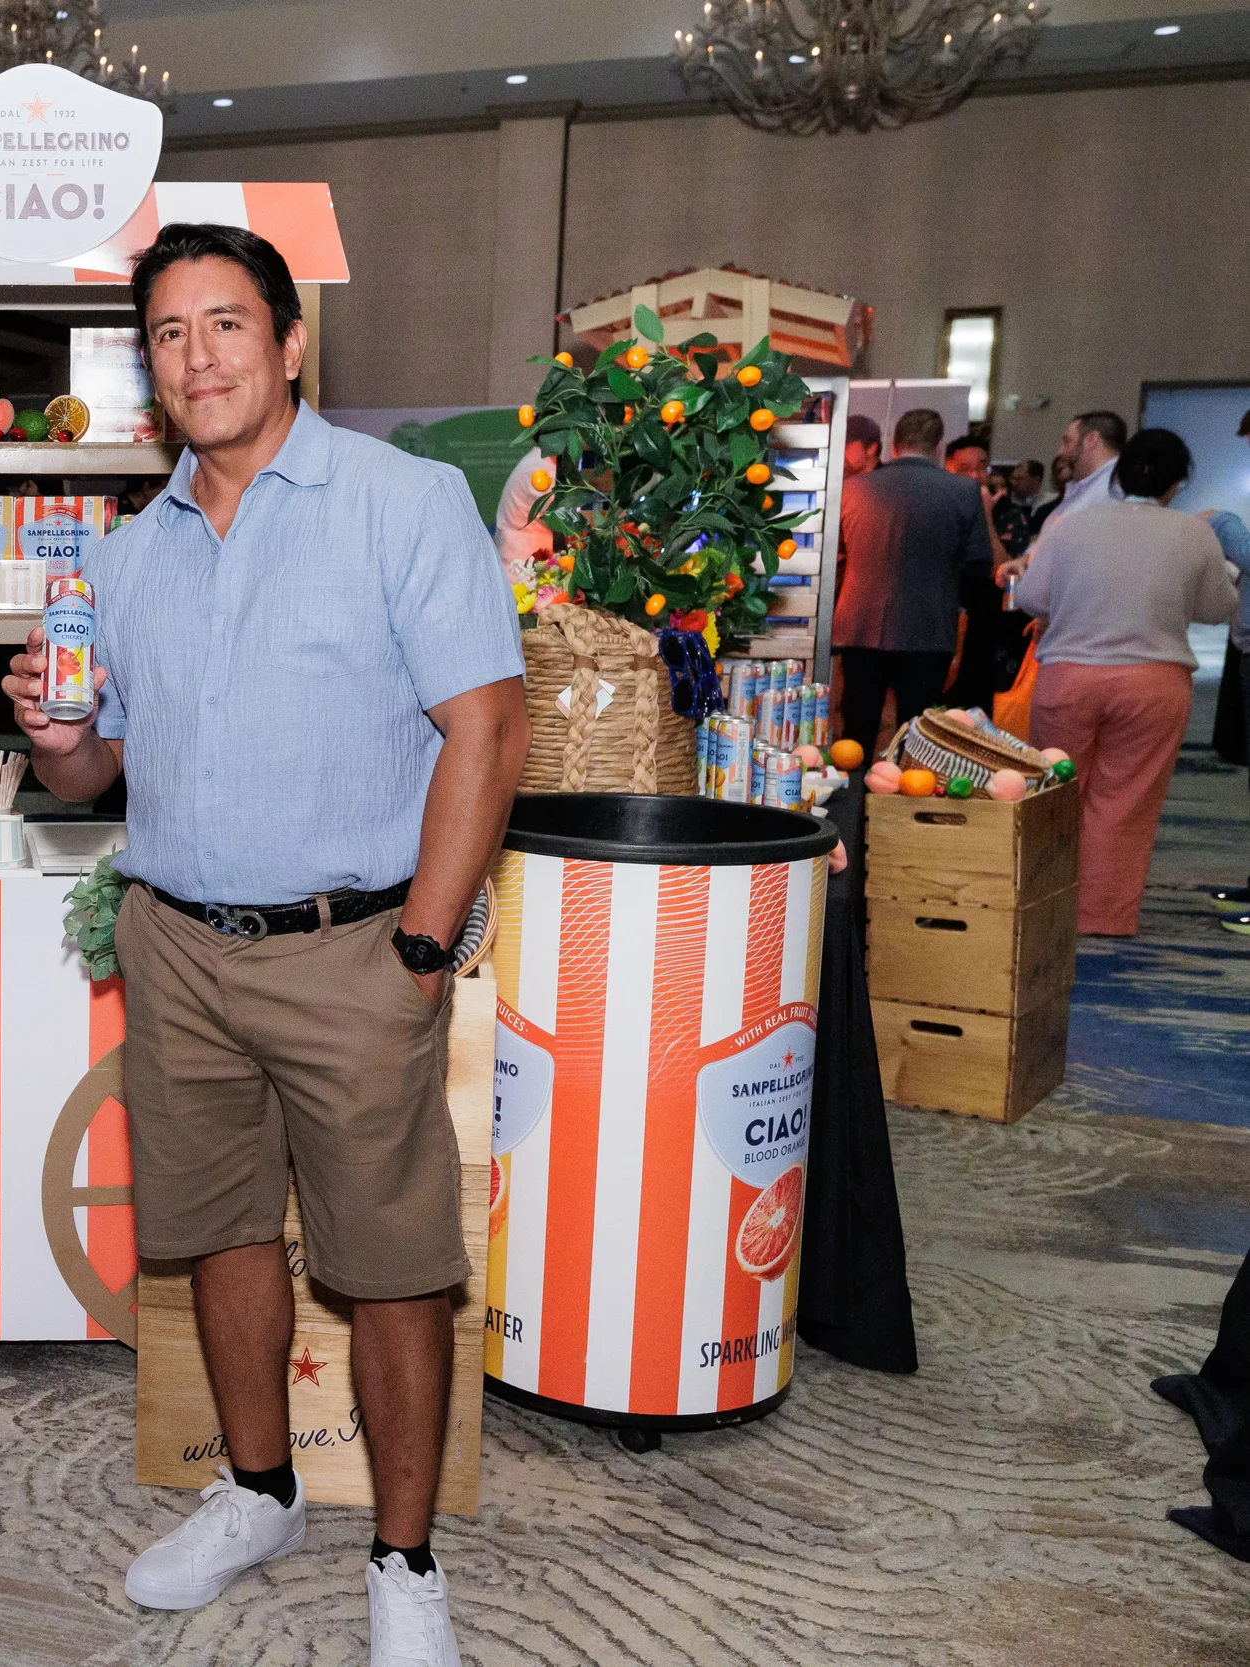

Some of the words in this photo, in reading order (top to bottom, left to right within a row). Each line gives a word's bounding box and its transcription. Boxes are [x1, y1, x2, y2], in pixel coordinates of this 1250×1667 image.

[0, 110, 21, 118] DAL
[54, 110, 76, 118] 1932
[22, 159, 48, 167] ZEST
[54, 159, 75, 167] FOR
[82, 159, 104, 167] LIFE
[36, 545, 80, 557] CIAO!
[53, 623, 89, 636] CIAO!
[735, 1024, 763, 1048] WITH
[765, 1010, 788, 1030] REAL
[790, 1006, 809, 1019] FRUIT
[732, 1064, 814, 1098] SANPELLEGR
[749, 1099, 776, 1108] ITALIAN
[745, 1104, 808, 1146] CIAO!
[744, 1148, 779, 1164] BLOOD
[485, 1305, 523, 1343] ATER
[700, 1325, 780, 1368] SPARKLING
[183, 1433, 230, 1461] wit
[289, 1428, 335, 1449] ove,
